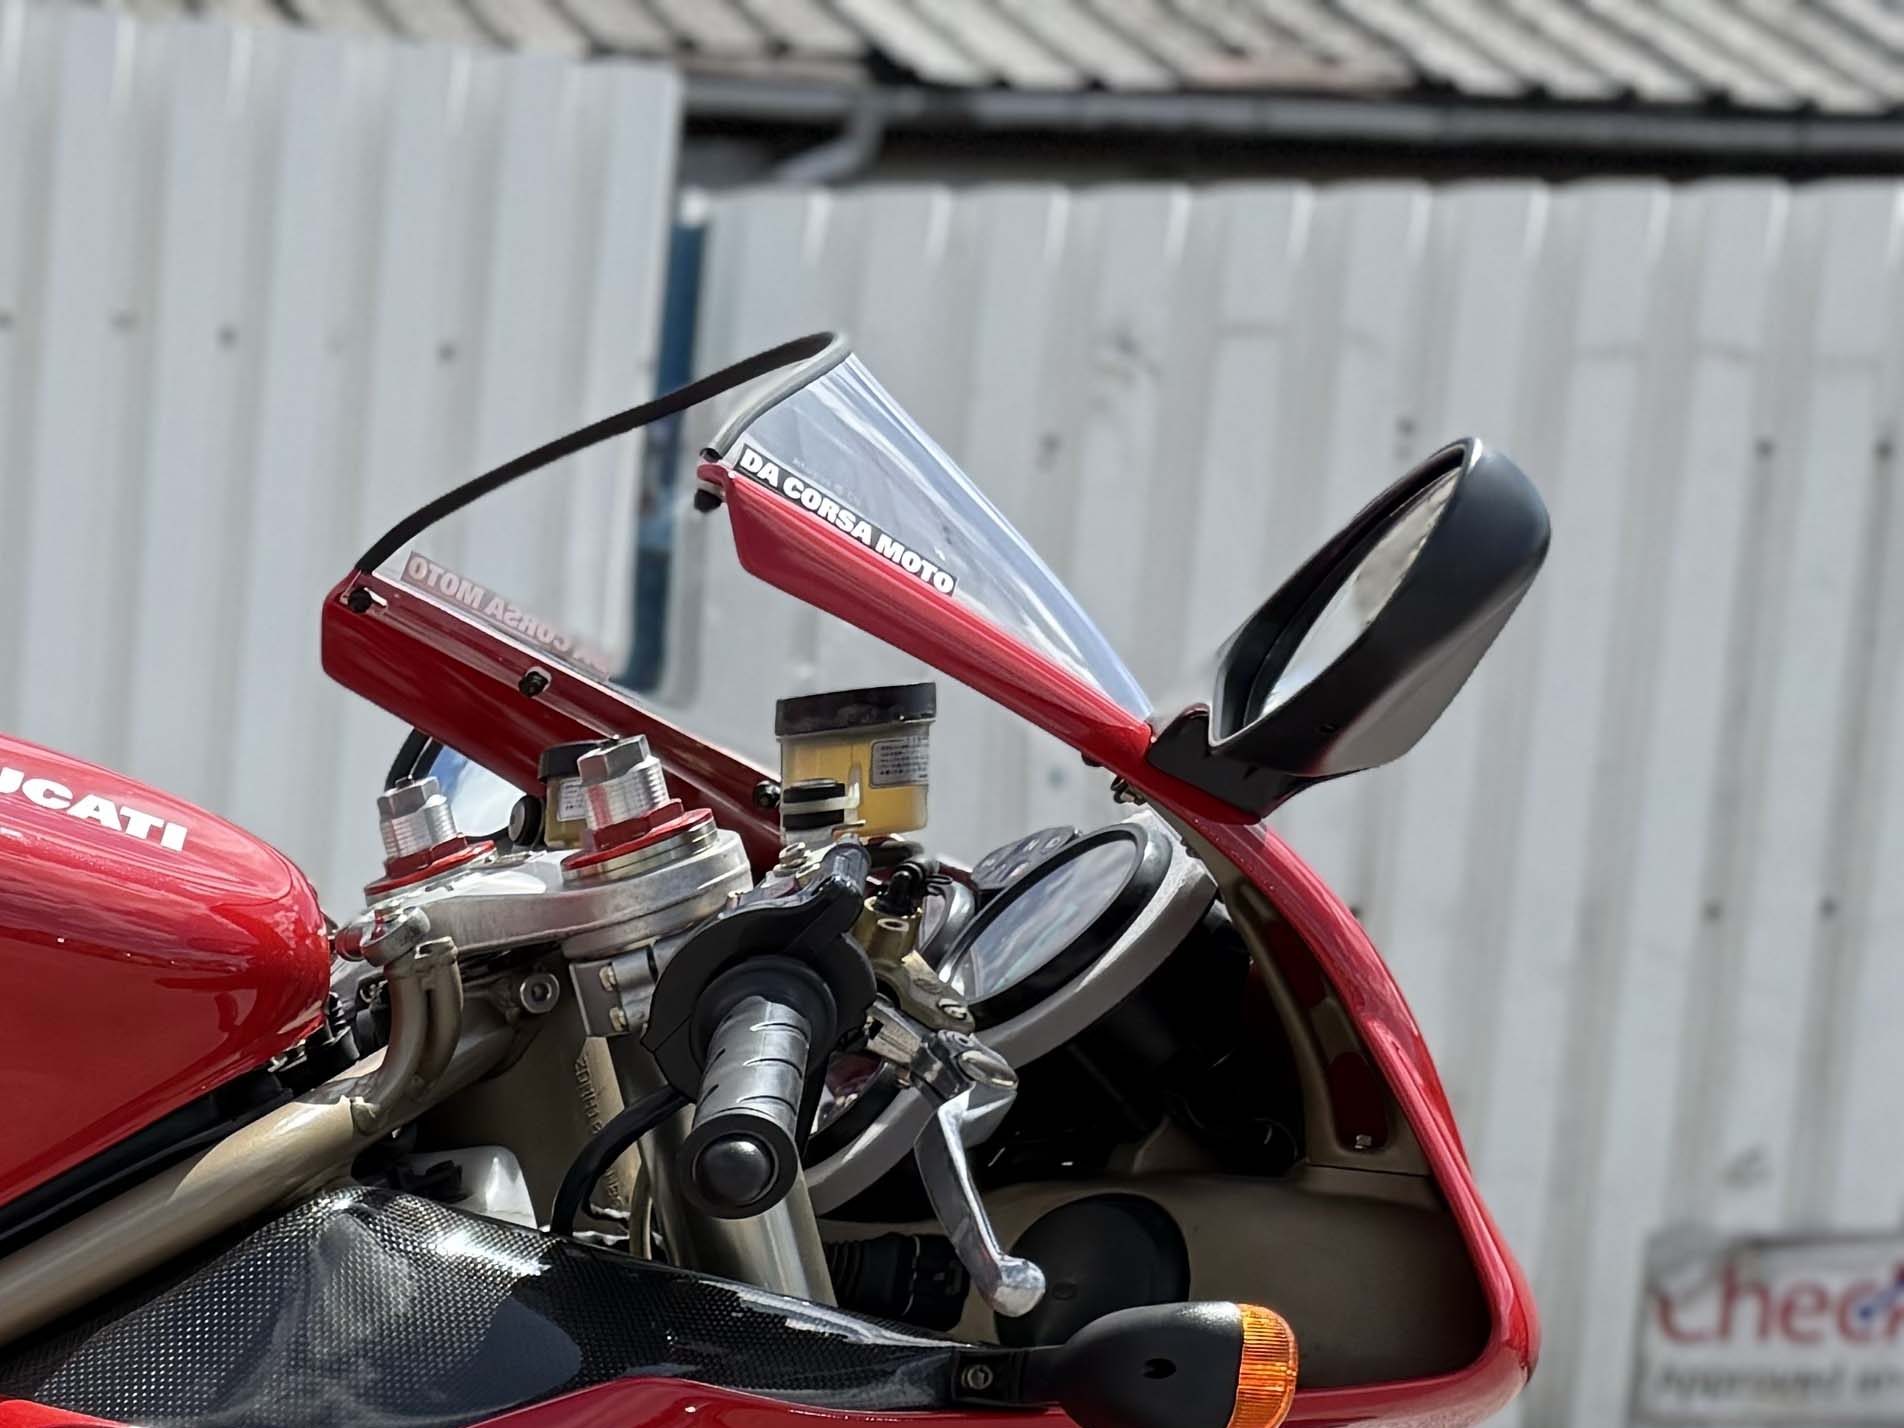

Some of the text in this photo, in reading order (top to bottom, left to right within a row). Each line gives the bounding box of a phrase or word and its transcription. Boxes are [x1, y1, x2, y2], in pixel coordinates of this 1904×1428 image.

[740, 447, 955, 594] DA CORSA MOTO
